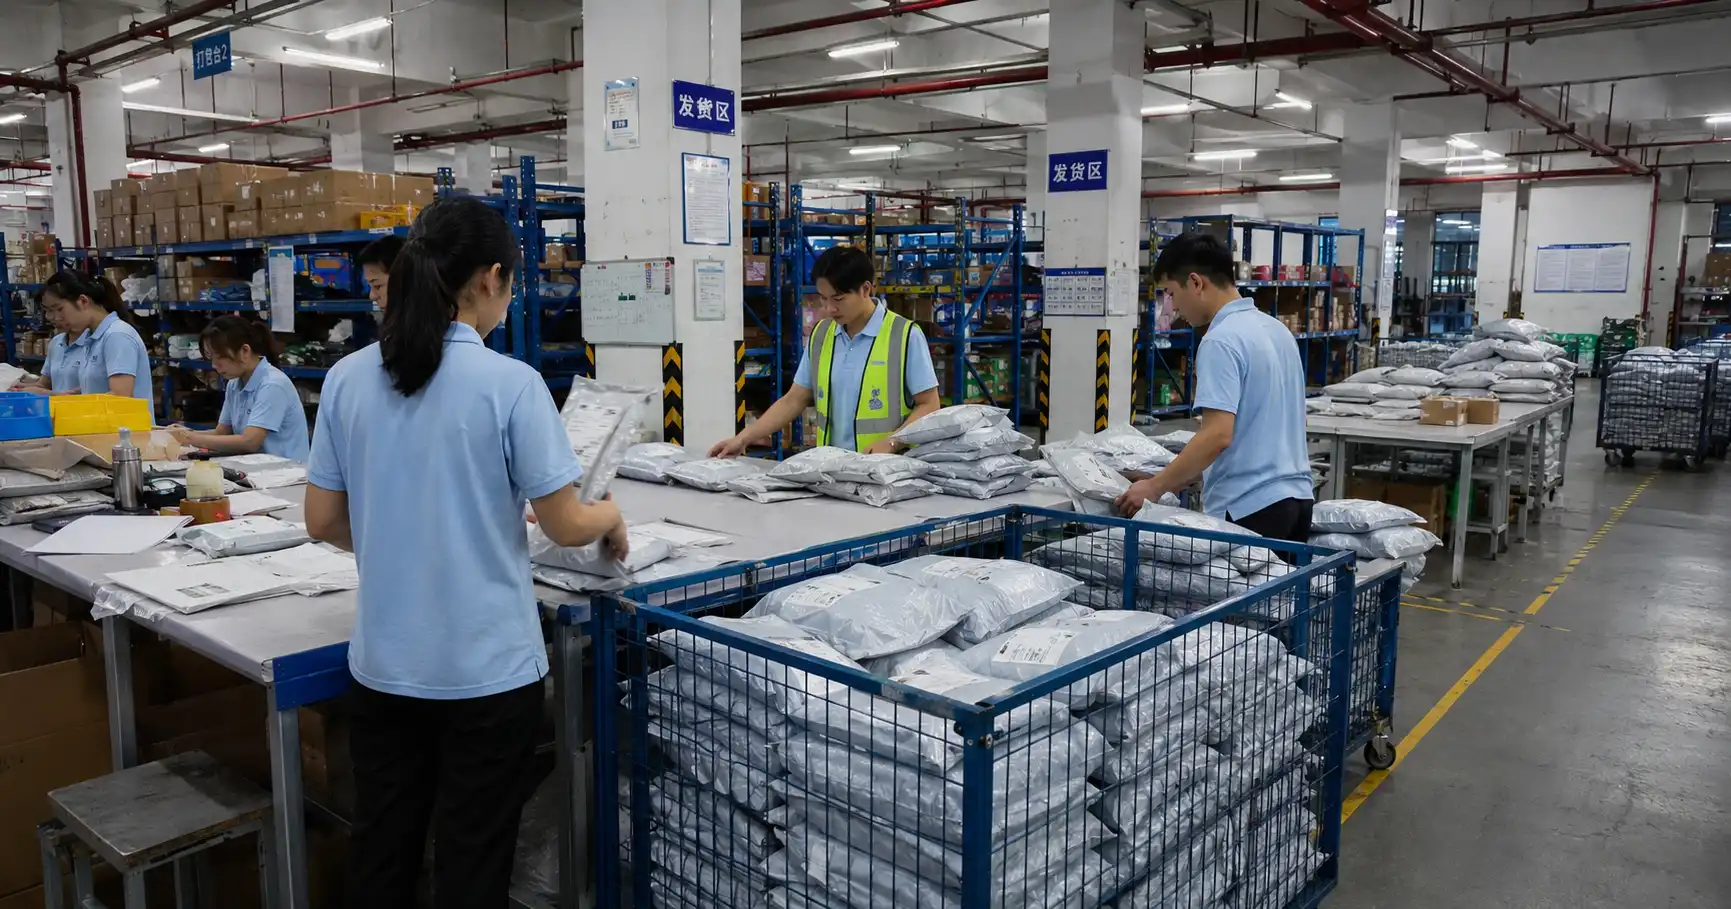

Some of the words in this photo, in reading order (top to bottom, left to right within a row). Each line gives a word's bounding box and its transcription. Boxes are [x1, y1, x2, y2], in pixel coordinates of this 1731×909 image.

[679, 94, 730, 122] 发货区
[1053, 162, 1103, 183] 发货区
